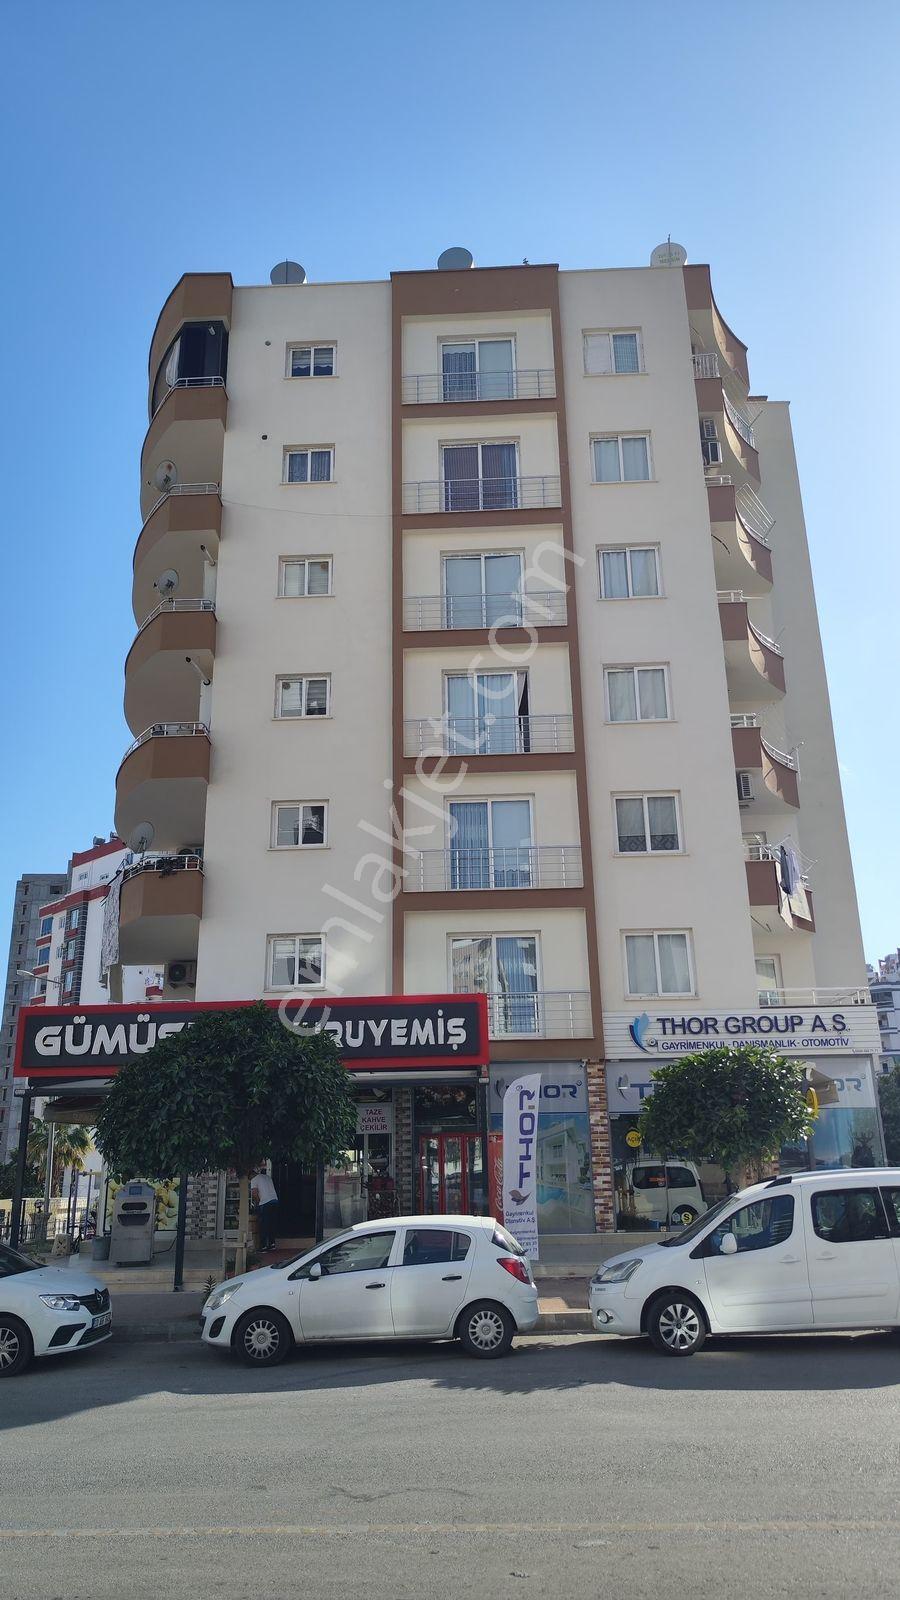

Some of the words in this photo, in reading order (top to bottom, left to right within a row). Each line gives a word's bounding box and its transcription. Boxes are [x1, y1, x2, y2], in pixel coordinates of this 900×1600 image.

[296, 1009, 468, 1051] RUYEMİŞ
[656, 1017, 719, 1037] THOR
[724, 1015, 804, 1034] GROUP
[365, 1108, 383, 1116] TAZE
[518, 1089, 536, 1189] THOR
